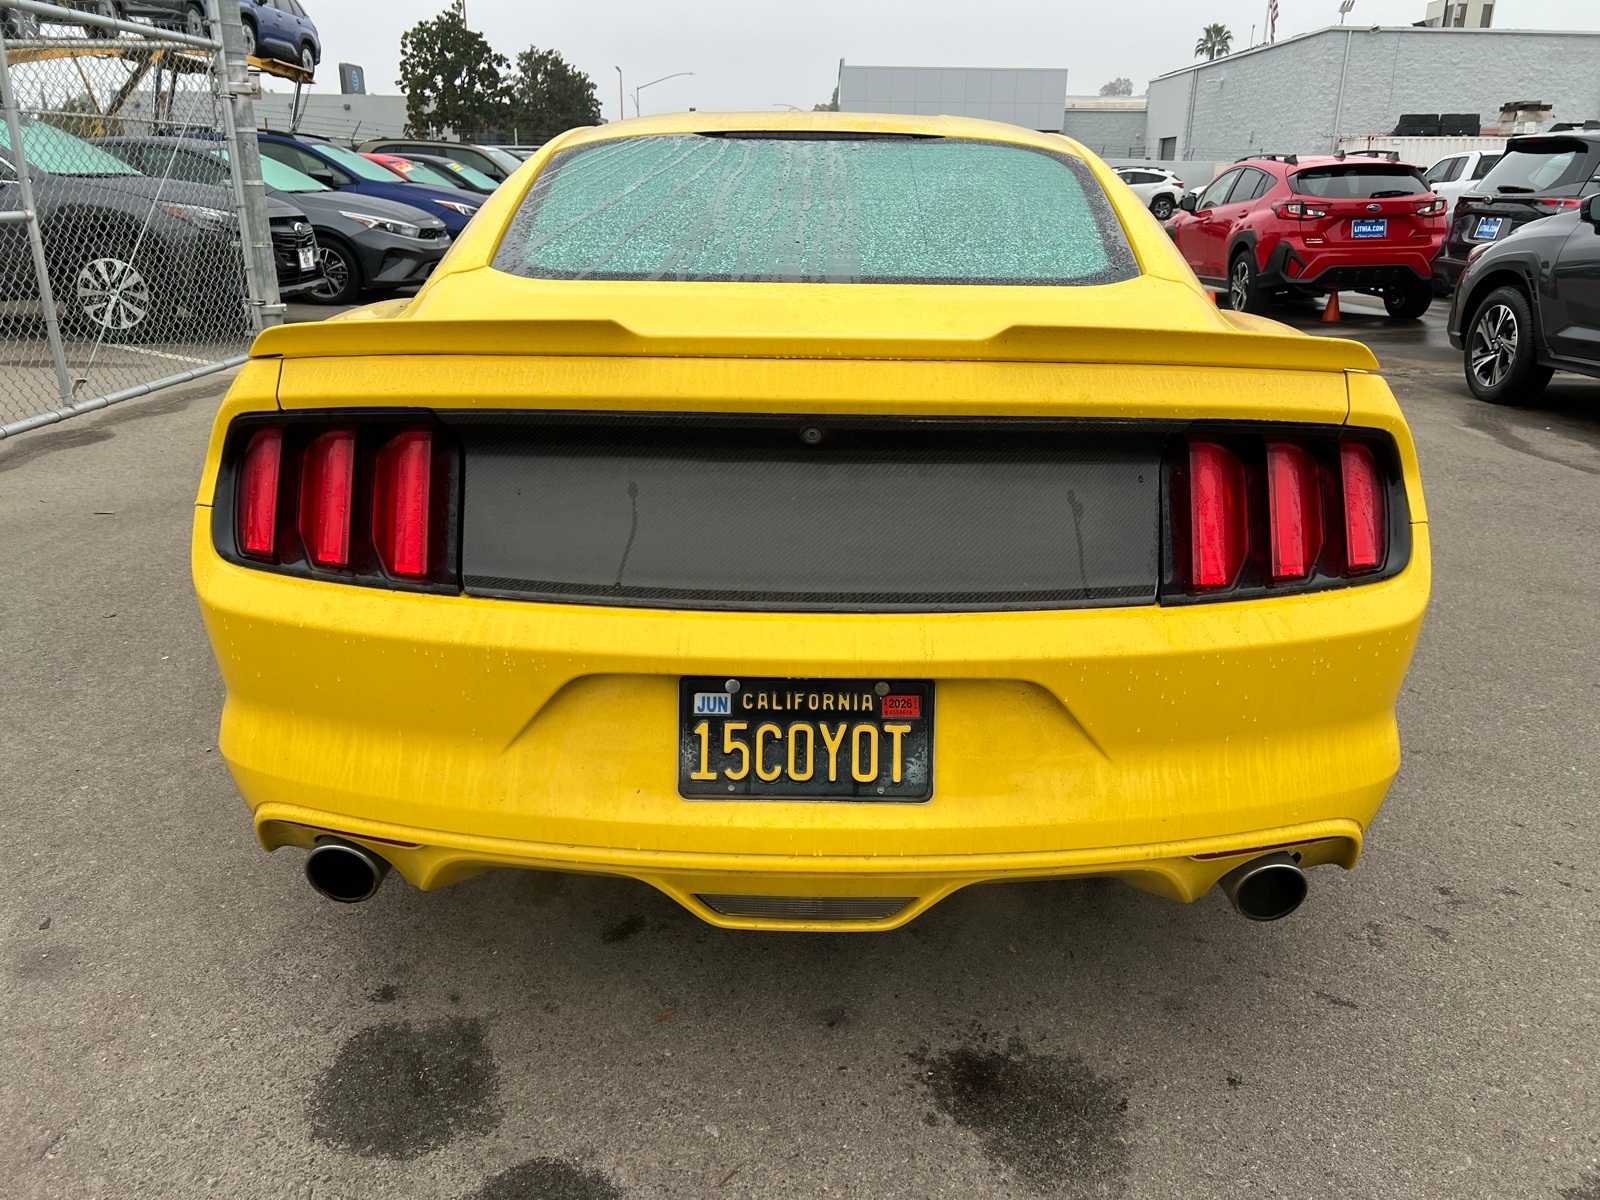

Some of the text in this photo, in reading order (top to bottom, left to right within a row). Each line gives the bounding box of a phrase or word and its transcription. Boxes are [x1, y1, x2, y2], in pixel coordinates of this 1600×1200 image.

[697, 696, 728, 712] JUN
[742, 692, 873, 711] CALIFORNIA
[690, 722, 912, 783] 15COYOT
